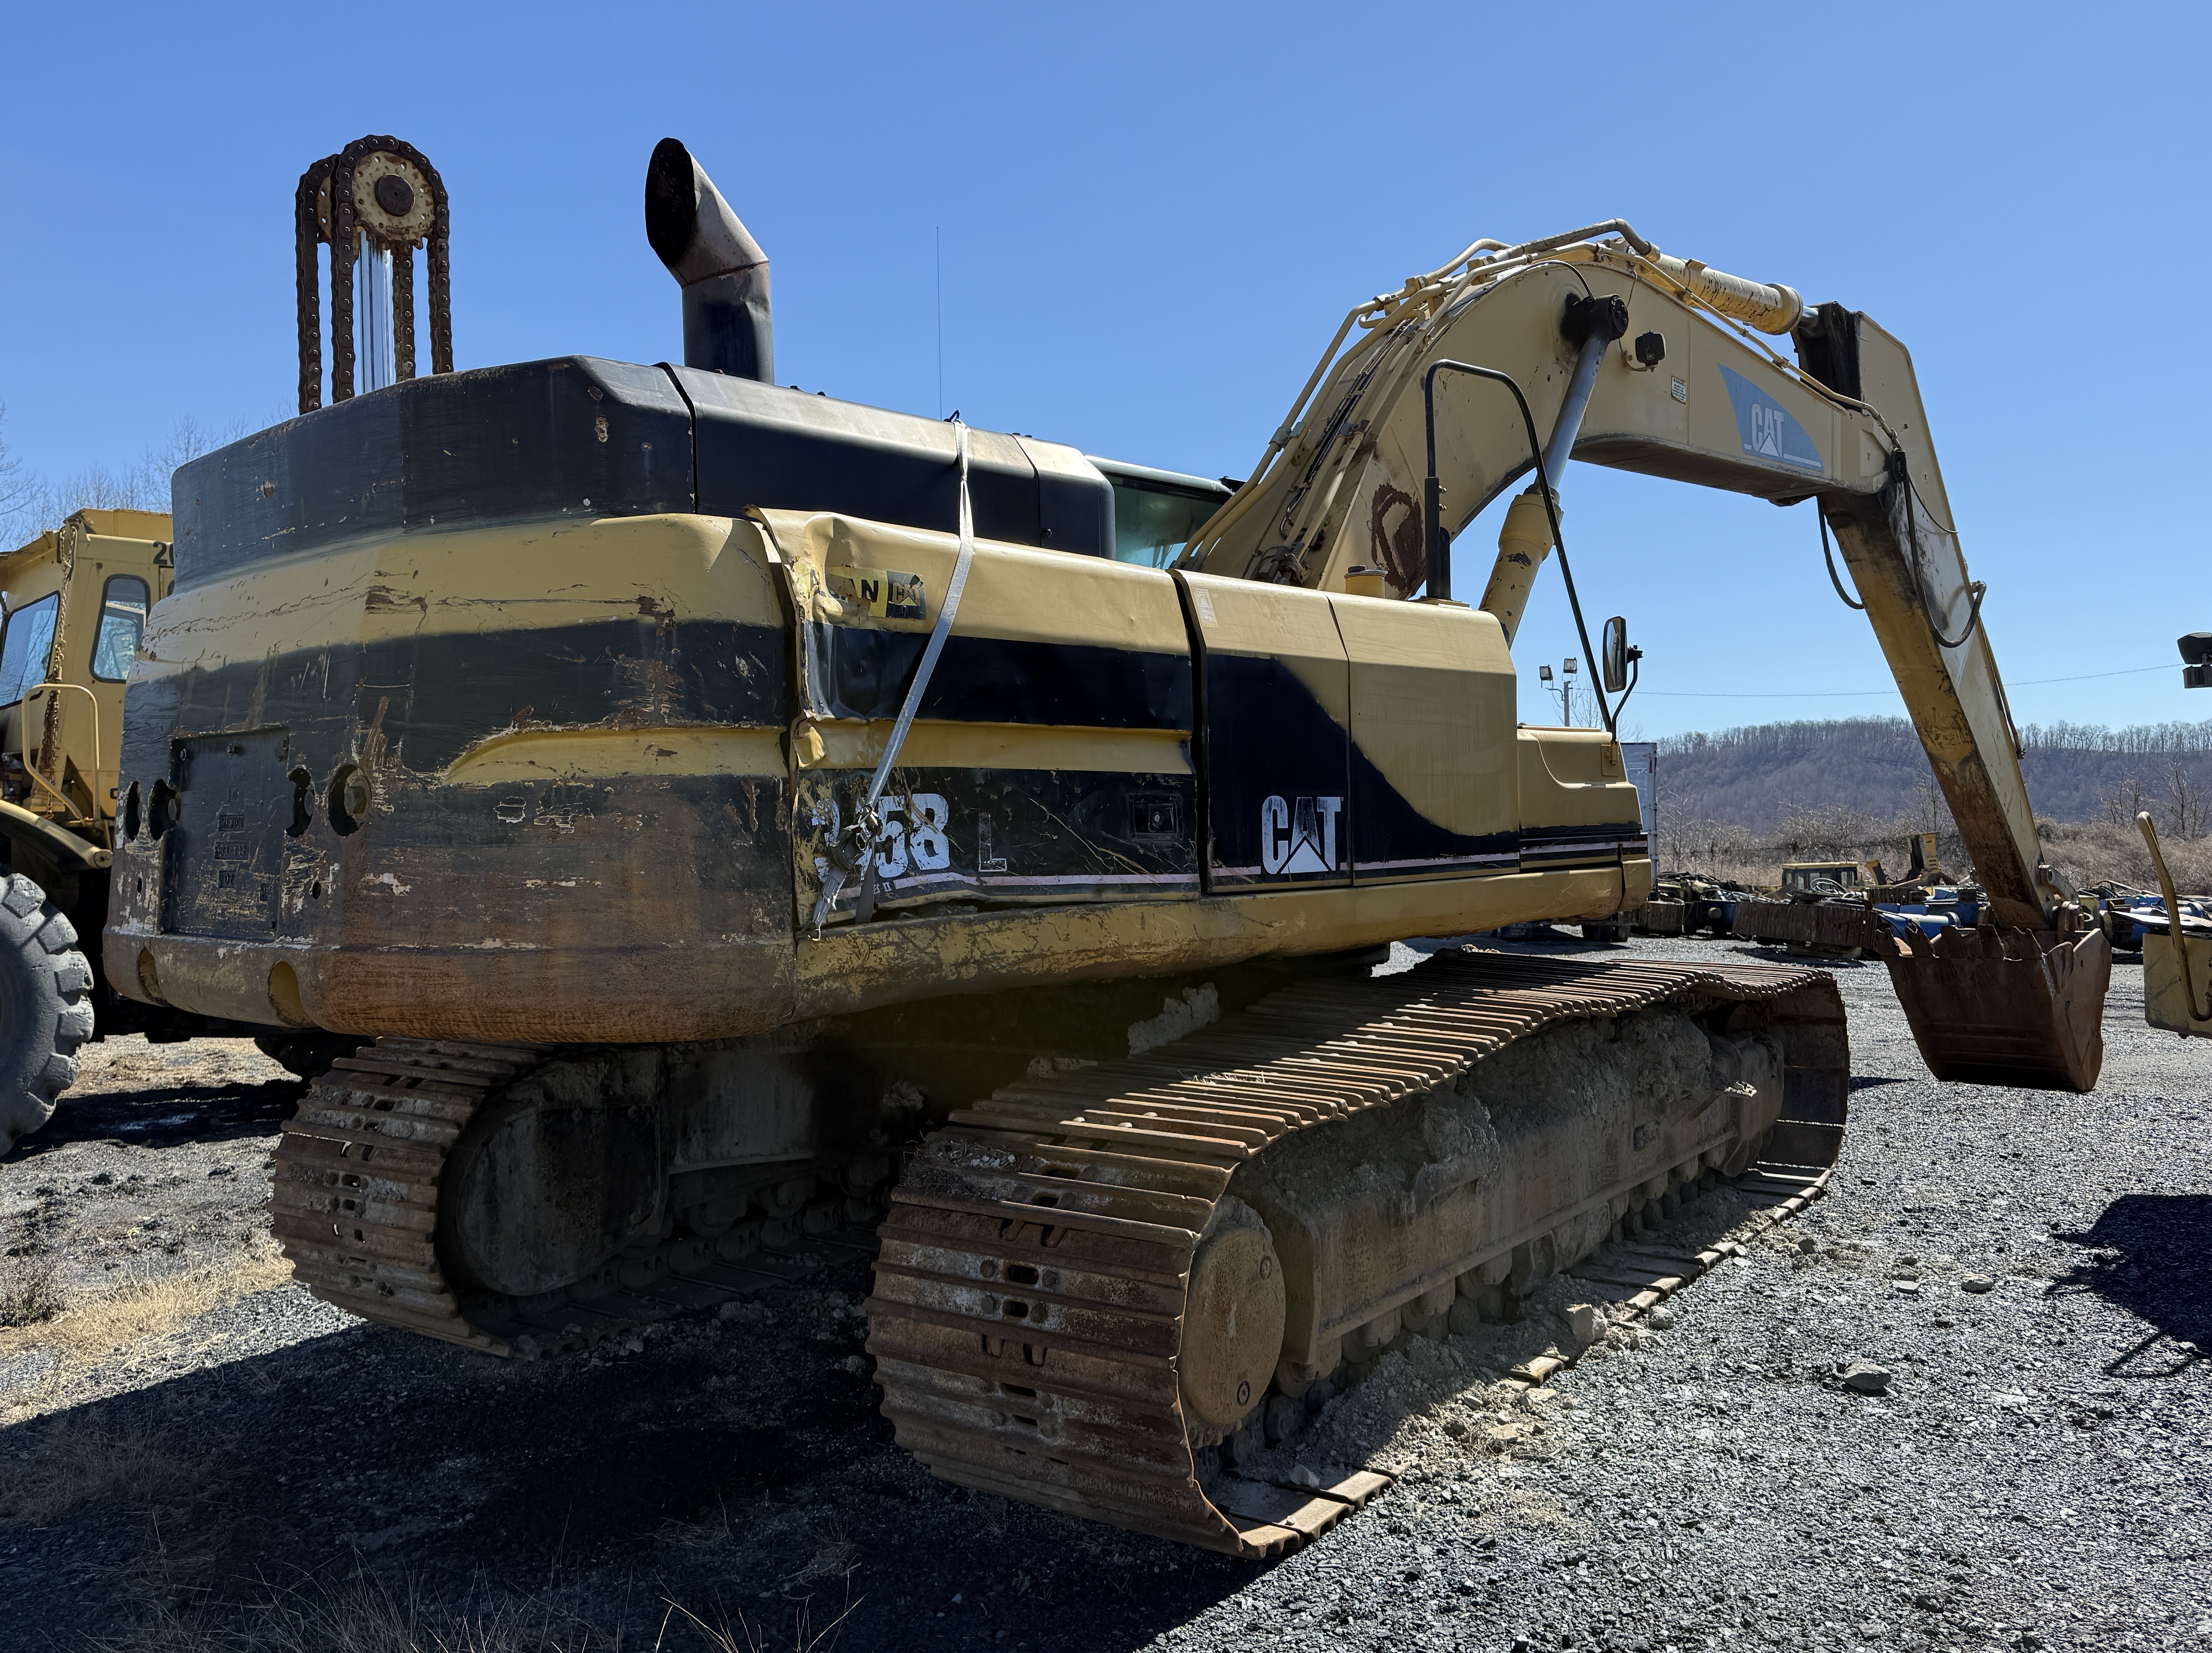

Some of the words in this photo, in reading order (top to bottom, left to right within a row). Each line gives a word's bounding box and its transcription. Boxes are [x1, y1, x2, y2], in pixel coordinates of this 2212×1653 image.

[1751, 404, 1784, 457] CAT
[811, 793, 950, 883] 5B
[978, 813, 1007, 872] L
[1262, 795, 1341, 874] CAT
